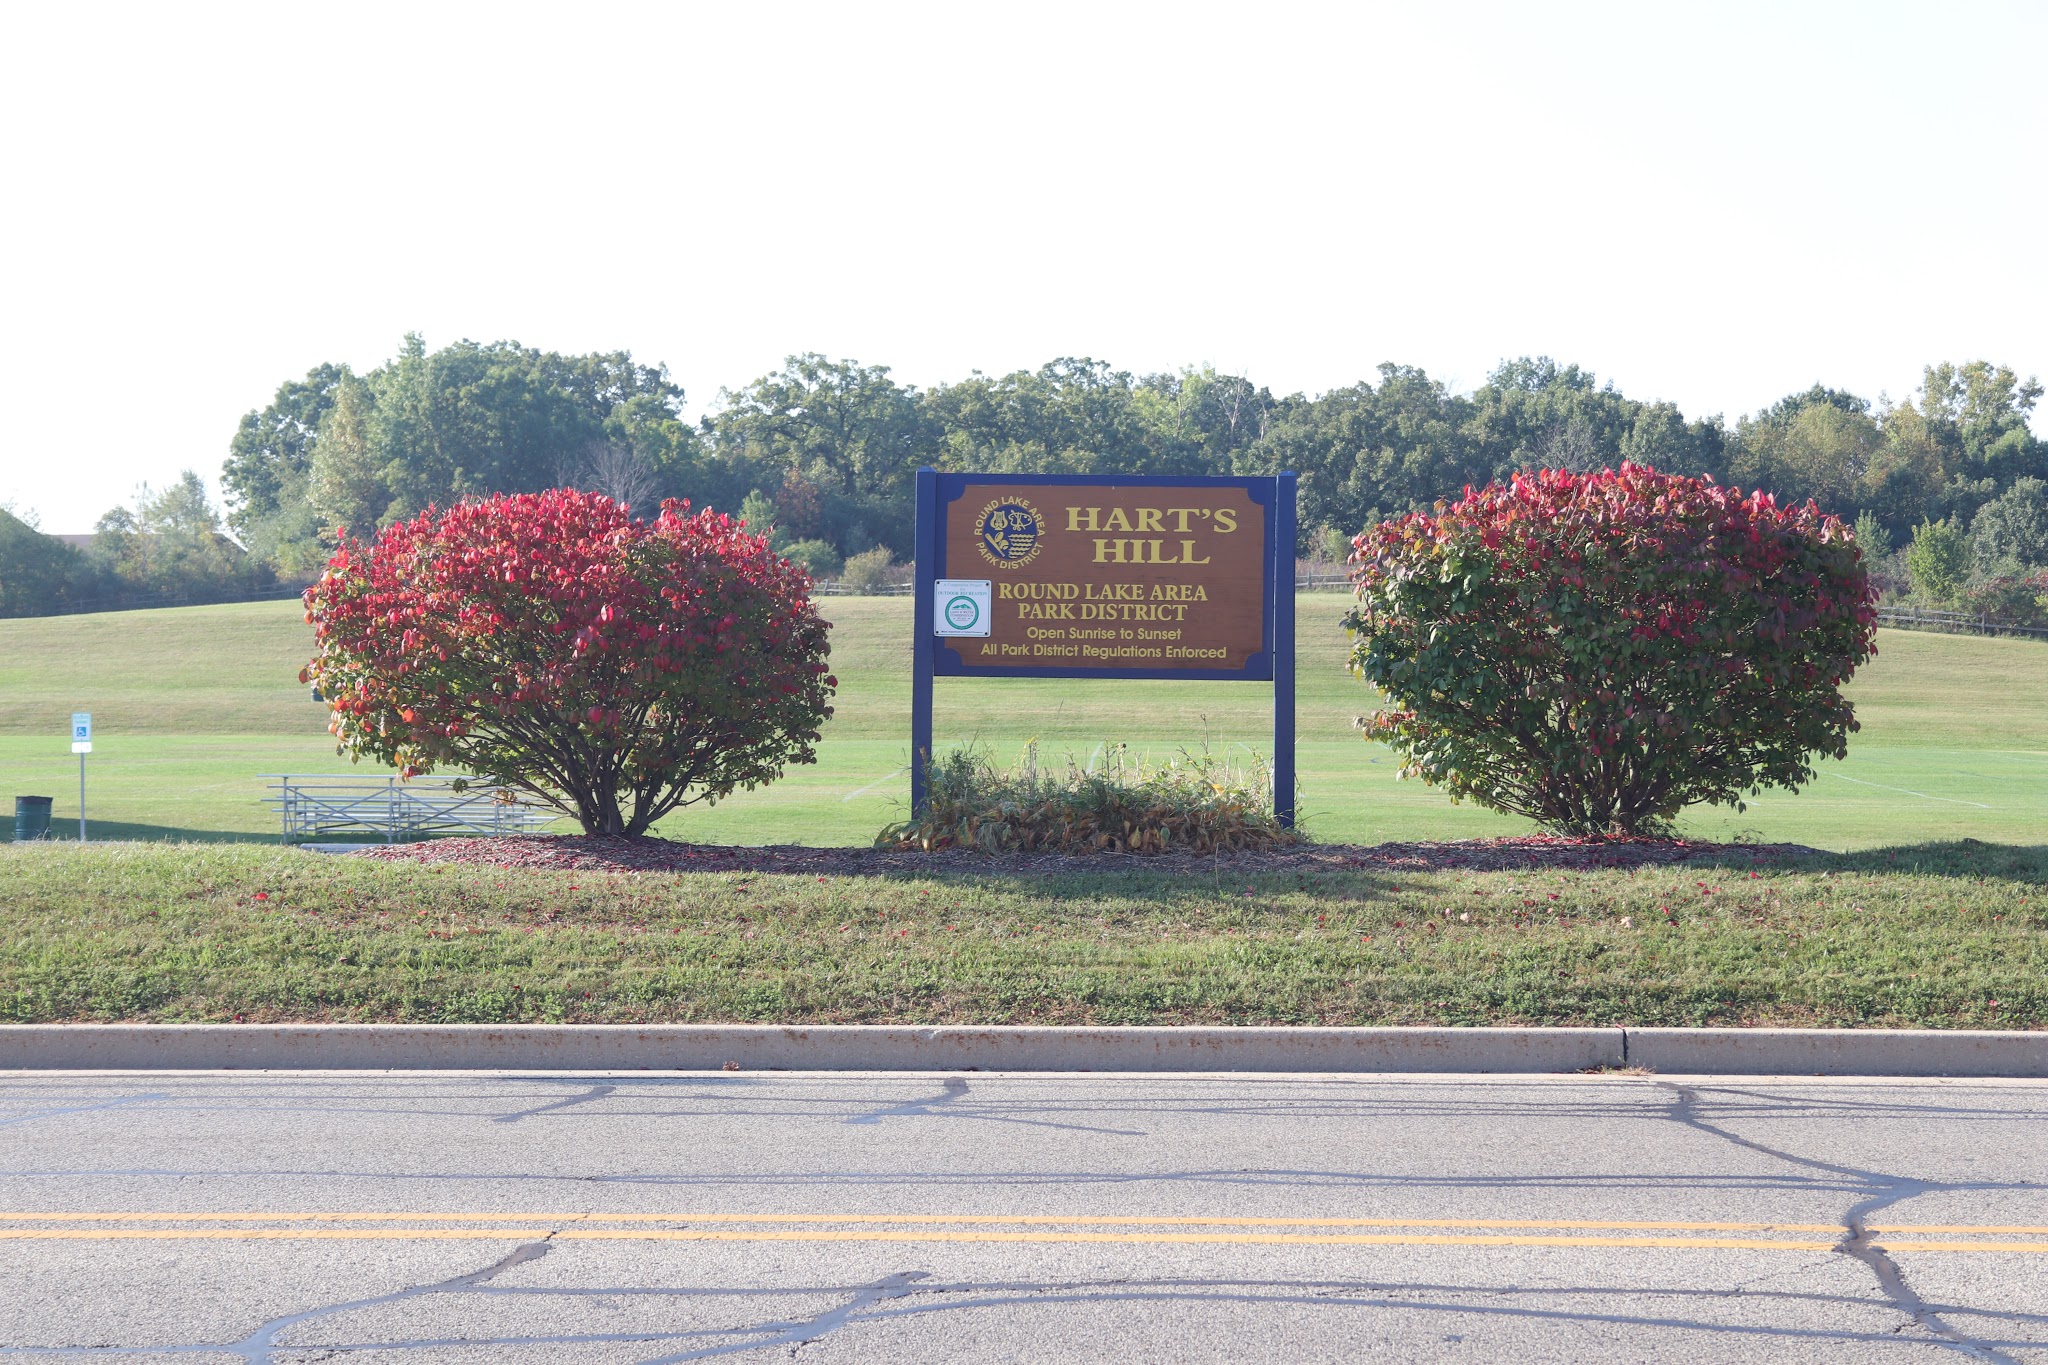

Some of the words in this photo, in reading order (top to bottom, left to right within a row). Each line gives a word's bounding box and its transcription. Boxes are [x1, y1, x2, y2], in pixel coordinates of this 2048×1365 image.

[974, 499, 999, 535] ROUND
[1001, 496, 1030, 509] LAKE
[1029, 508, 1046, 536] AREA
[1065, 507, 1238, 533] HART'S
[976, 542, 999, 566] PARK
[999, 542, 1043, 569] DISTRICT
[1092, 539, 1211, 564] HILL
[998, 583, 1079, 599] ROUND
[1085, 584, 1144, 600] LAKE
[1150, 585, 1208, 601] AREA
[1018, 603, 1075, 620] PARK
[1081, 604, 1188, 621] DISTRICT
[1027, 627, 1065, 641] Open
[1069, 628, 1116, 640] Sunrise
[1120, 628, 1134, 640] to
[1138, 628, 1182, 640] Sunset
[981, 644, 997, 656] All
[1002, 644, 1030, 656] Park
[1034, 645, 1079, 657] District
[1083, 646, 1162, 660] Regulations
[1166, 646, 1227, 659] Enforced
